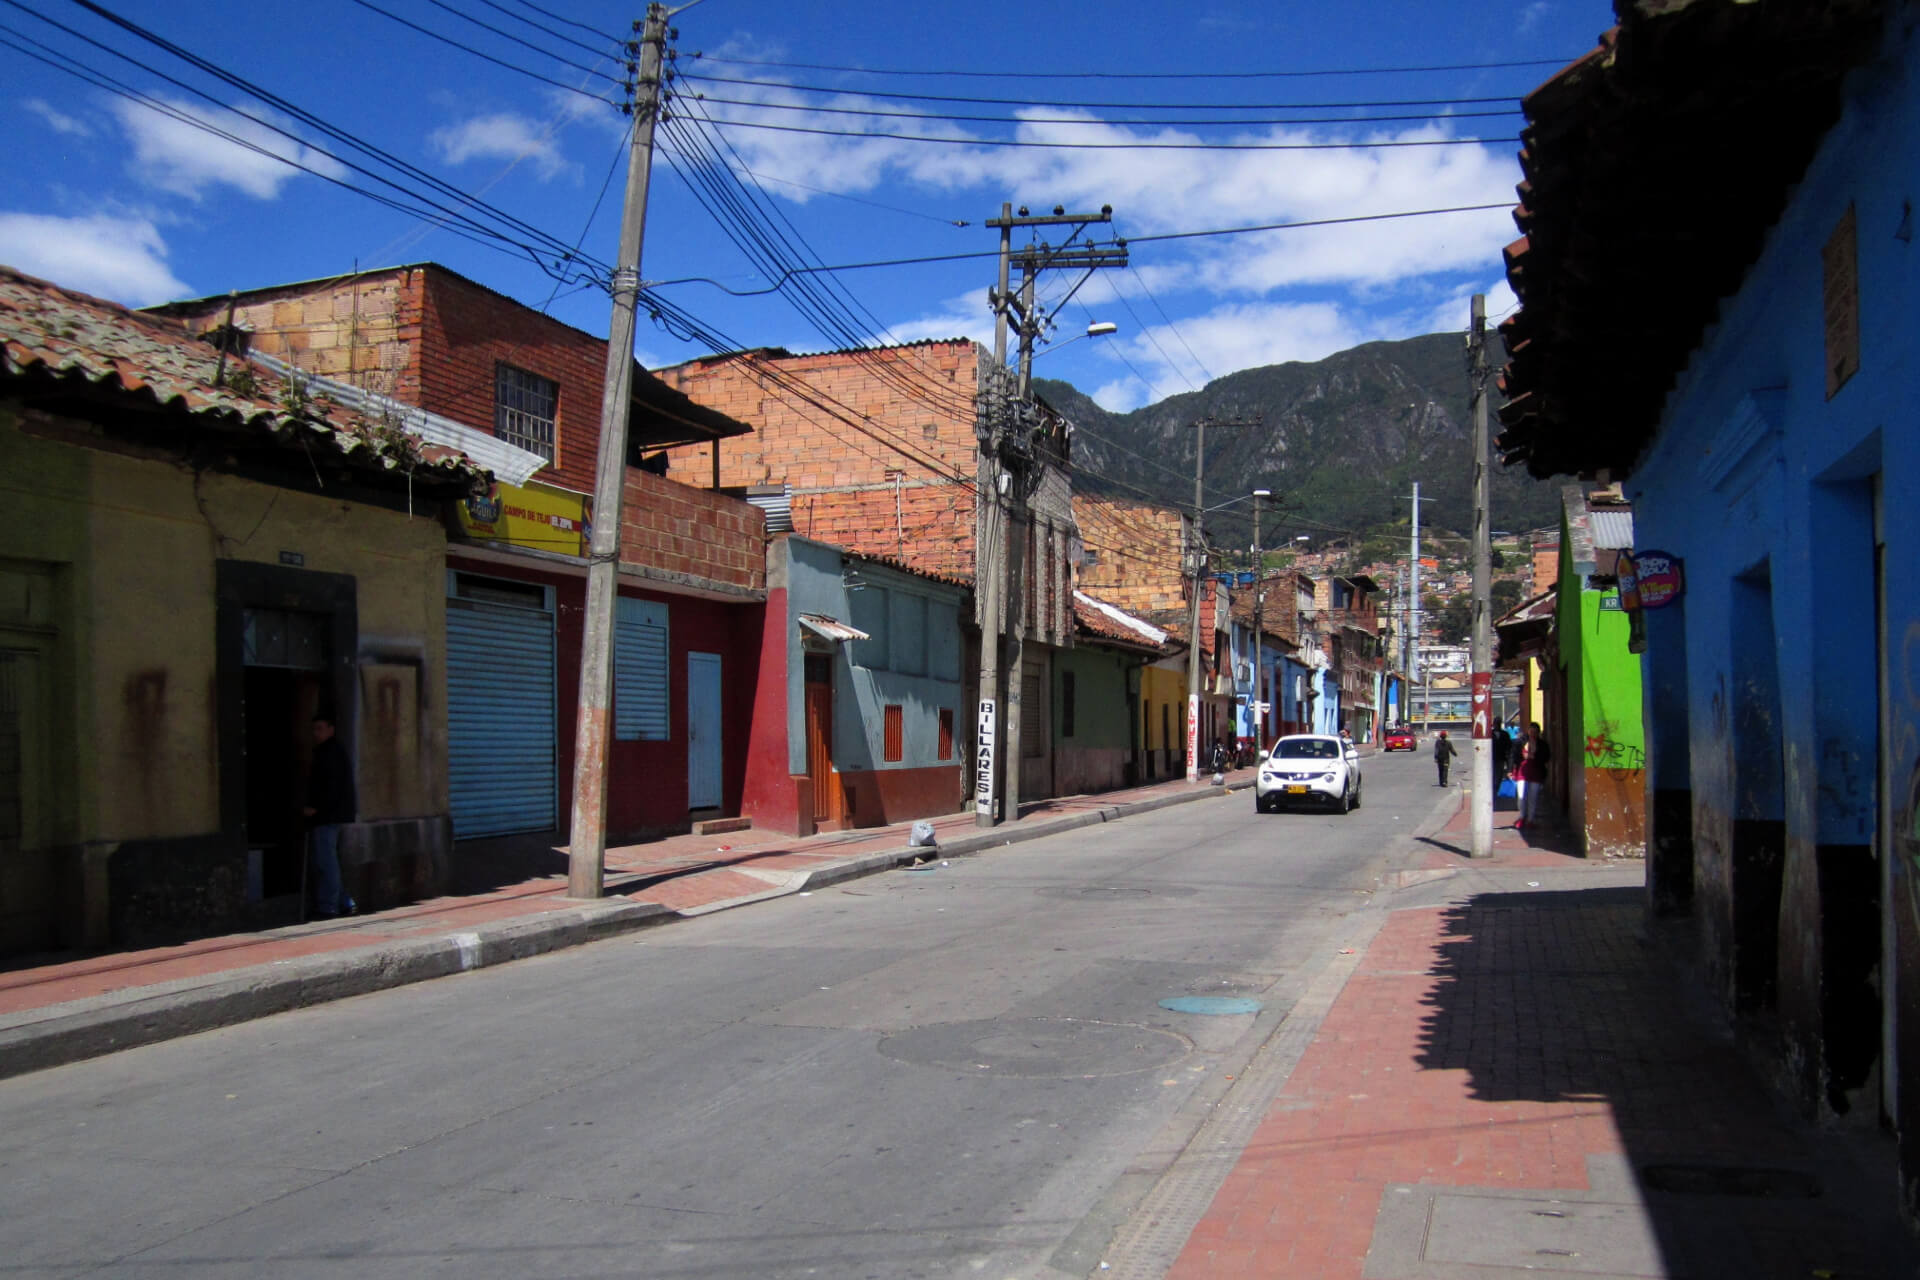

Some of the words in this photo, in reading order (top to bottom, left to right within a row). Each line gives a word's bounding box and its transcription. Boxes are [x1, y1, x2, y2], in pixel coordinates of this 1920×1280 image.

[504, 504, 526, 519] CAMPO
[527, 510, 536, 521] DE
[1605, 598, 1617, 608] KR
[977, 703, 993, 793] BILLARES
